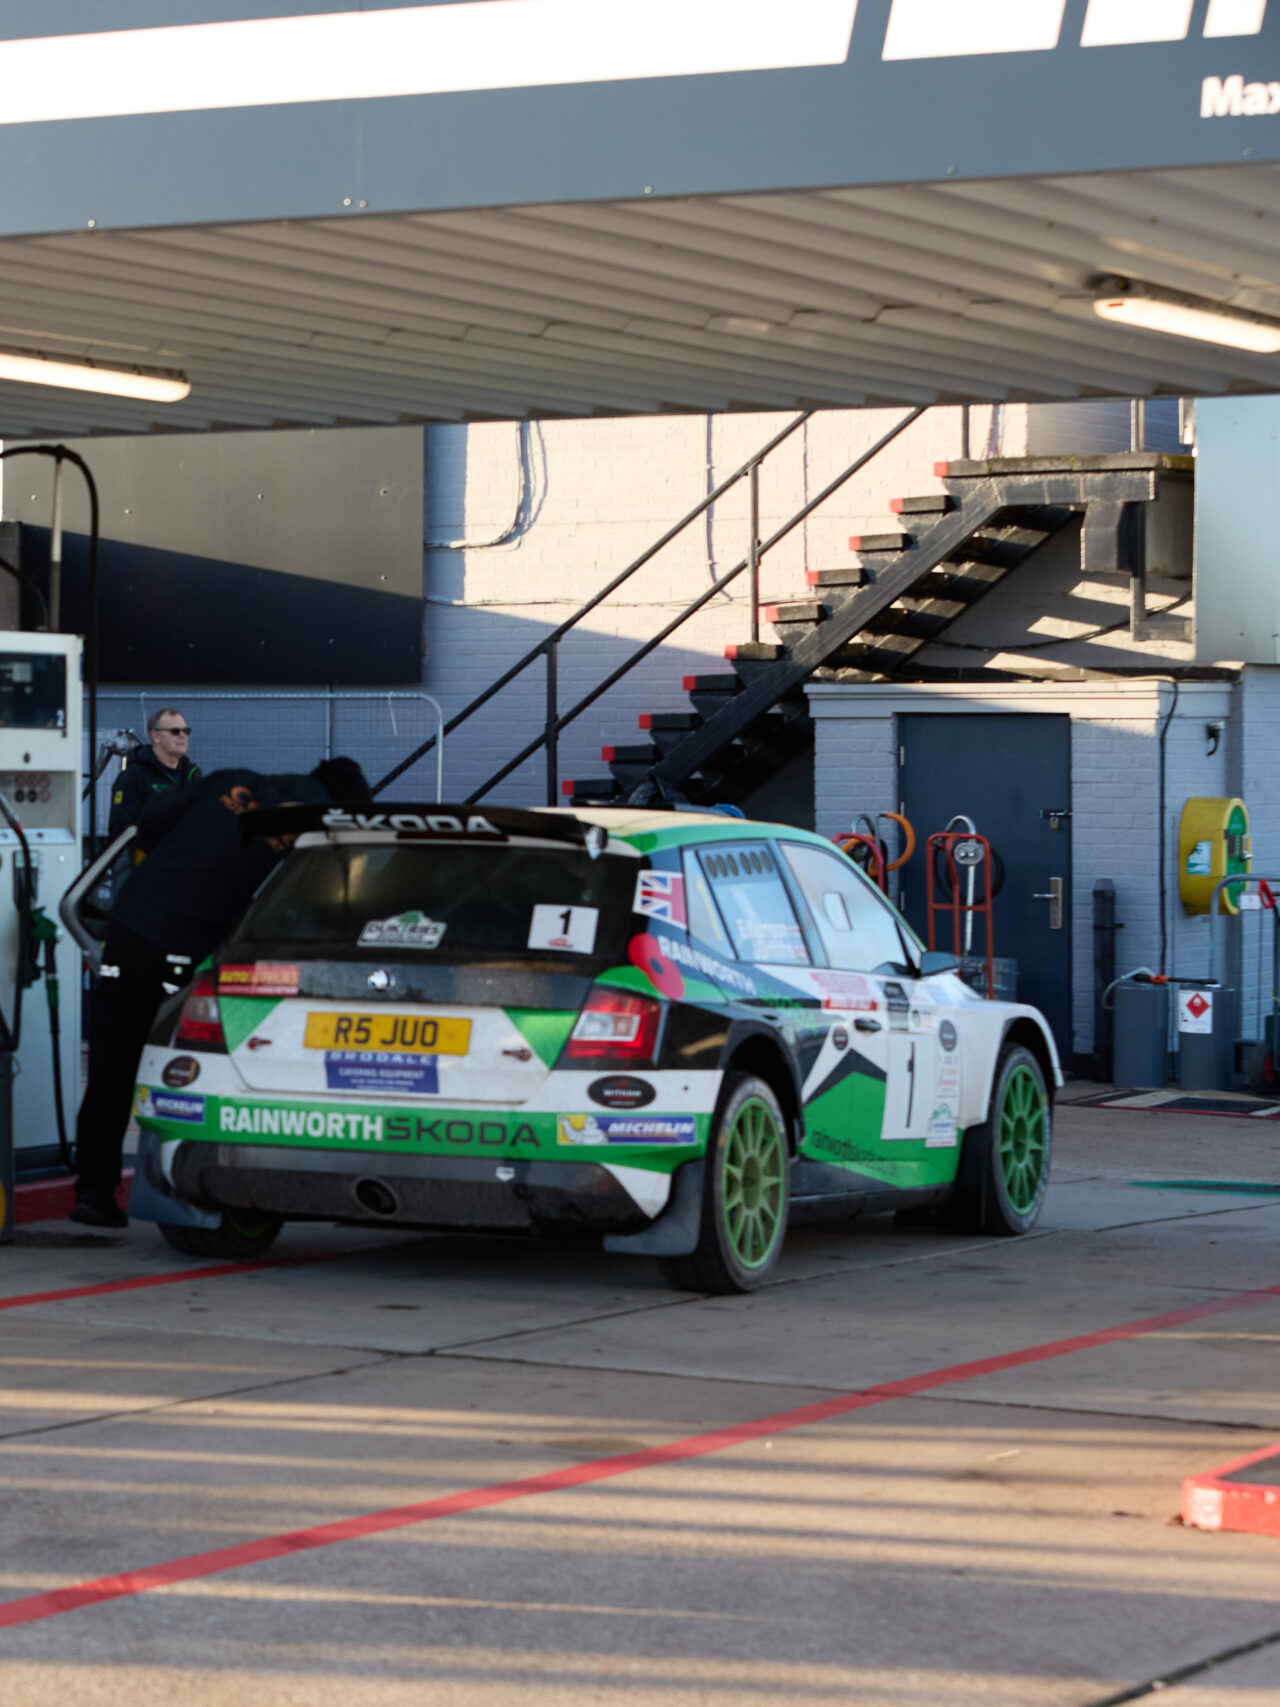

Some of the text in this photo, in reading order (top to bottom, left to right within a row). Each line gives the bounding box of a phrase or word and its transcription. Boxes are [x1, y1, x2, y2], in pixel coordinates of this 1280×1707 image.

[56, 709, 65, 727] 2
[321, 808, 503, 835] ŠKODA
[559, 907, 571, 935] 1
[334, 1017, 439, 1047] R5 JUO
[906, 1040, 915, 1129] 1
[156, 1096, 205, 1113] MICHELIN
[219, 1105, 541, 1148] RAINWORTH ŠKODA
[607, 1120, 695, 1137] MICHELIN
